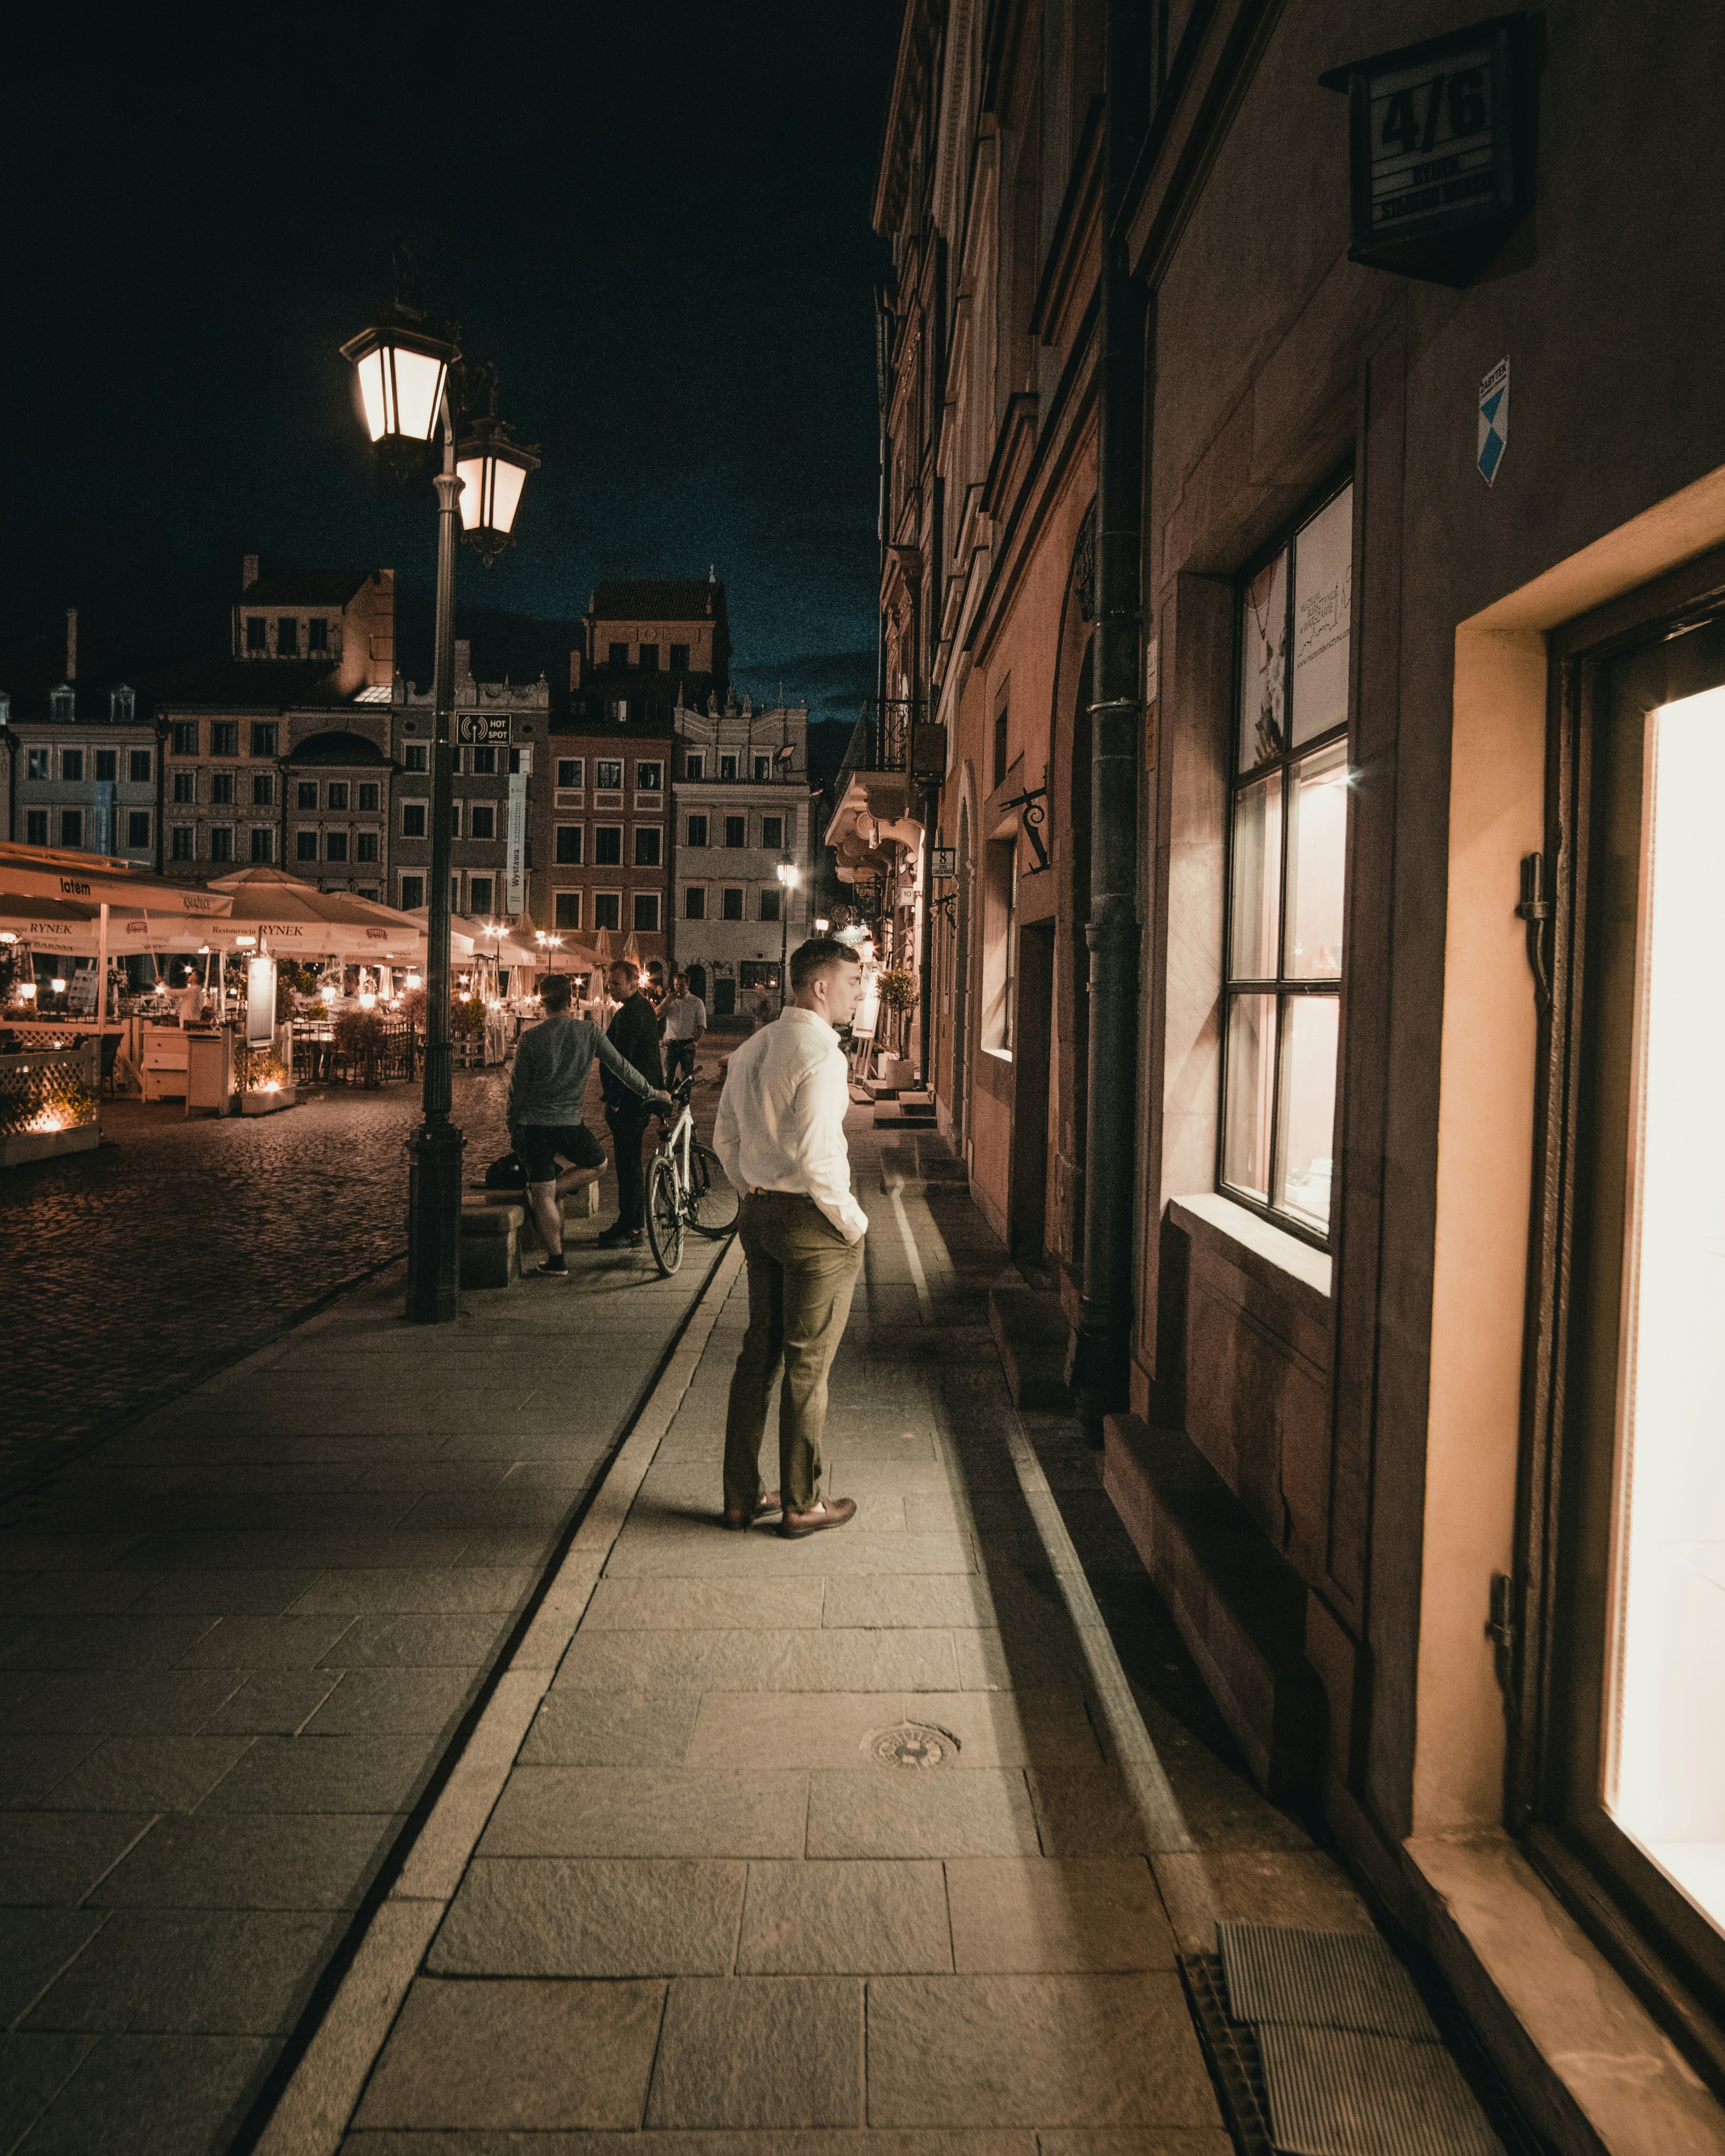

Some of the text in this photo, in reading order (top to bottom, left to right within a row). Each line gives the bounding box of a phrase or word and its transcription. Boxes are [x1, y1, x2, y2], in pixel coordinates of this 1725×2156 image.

[1382, 69, 1486, 153] 4/6
[1480, 364, 1506, 393] ZABYTEK
[490, 719, 506, 727] HOT
[940, 851, 946, 864] 8
[512, 849, 520, 887] Wystawa
[60, 877, 91, 896] latem
[30, 923, 72, 934] RYNEK
[212, 925, 303, 936] Restauracja RYNEK
